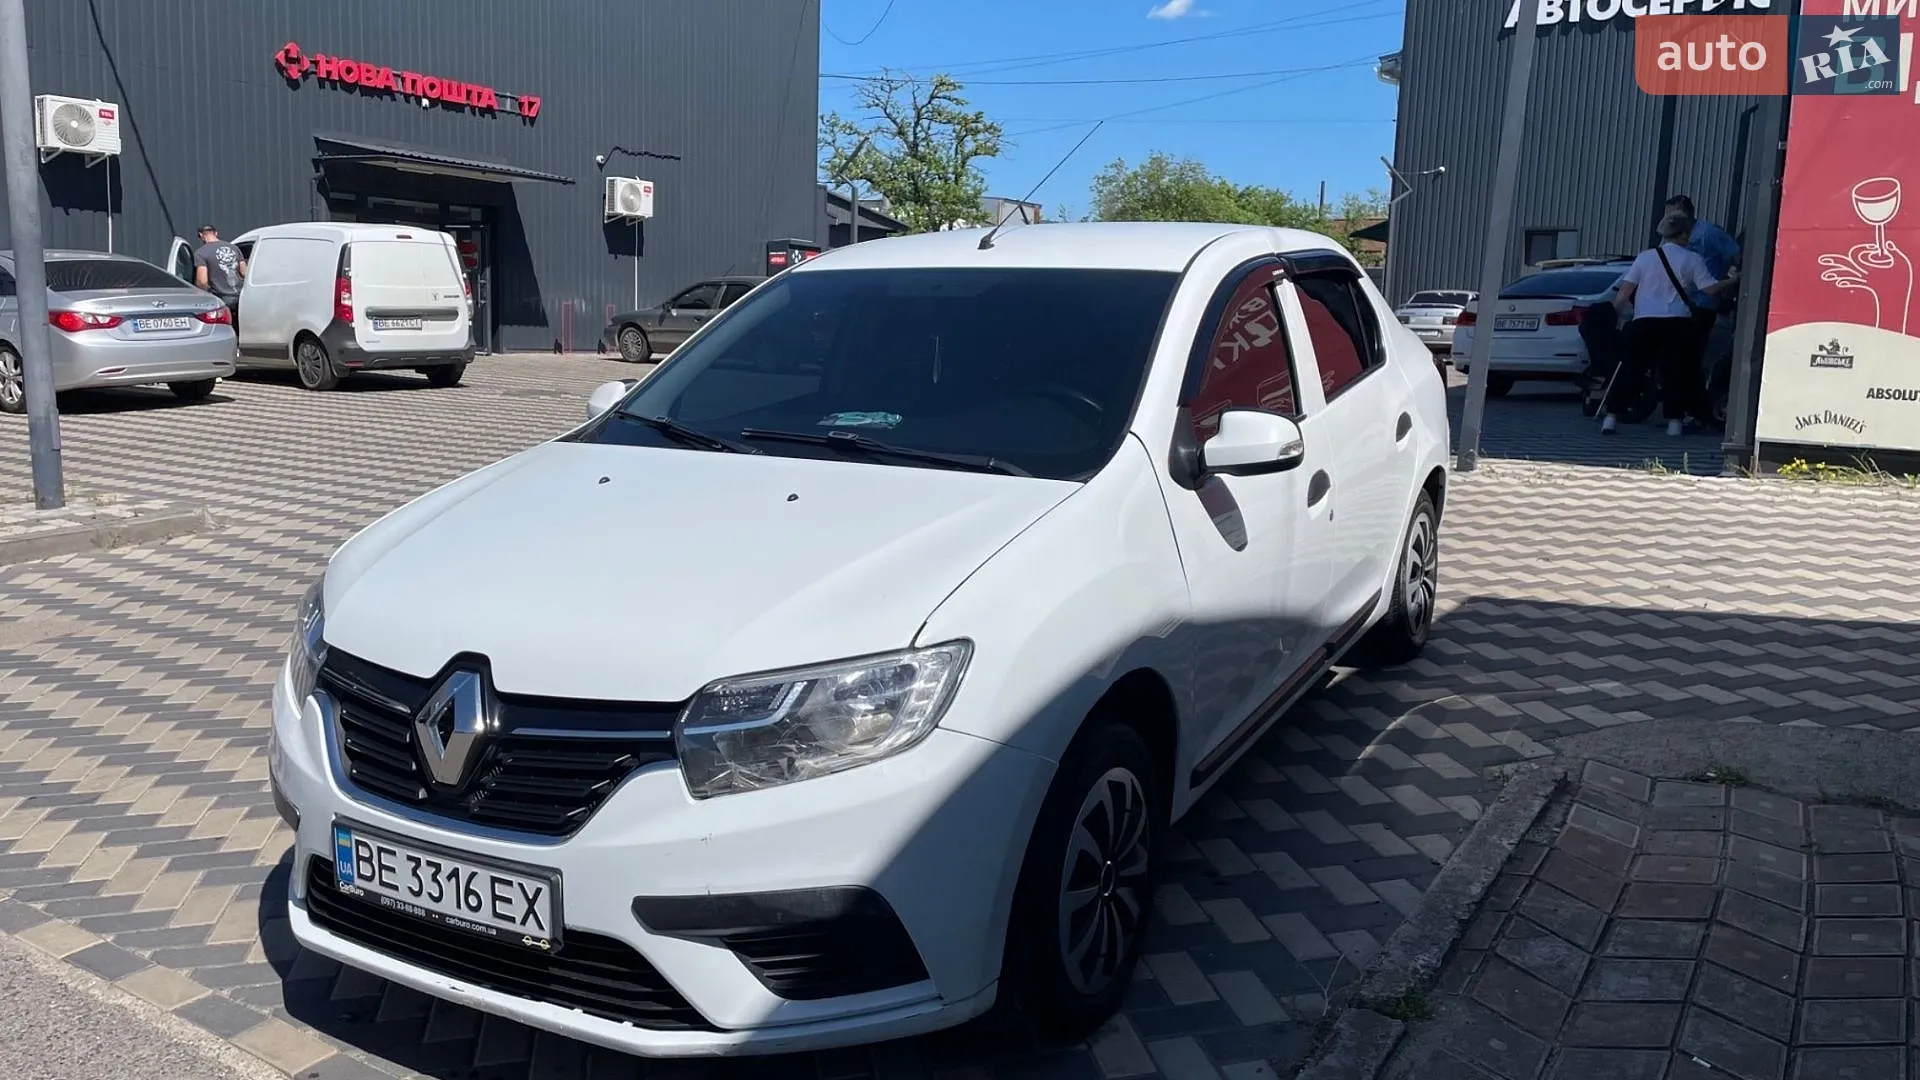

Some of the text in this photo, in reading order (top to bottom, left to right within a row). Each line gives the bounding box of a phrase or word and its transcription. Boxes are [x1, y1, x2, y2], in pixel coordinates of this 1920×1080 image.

[316, 53, 541, 118] НОВА ПОШТА 17
[1866, 387, 1920, 401] ABSOLU
[1795, 413, 1822, 431] JACK
[340, 861, 353, 876] UA
[354, 838, 546, 932] BE 3316 EX
